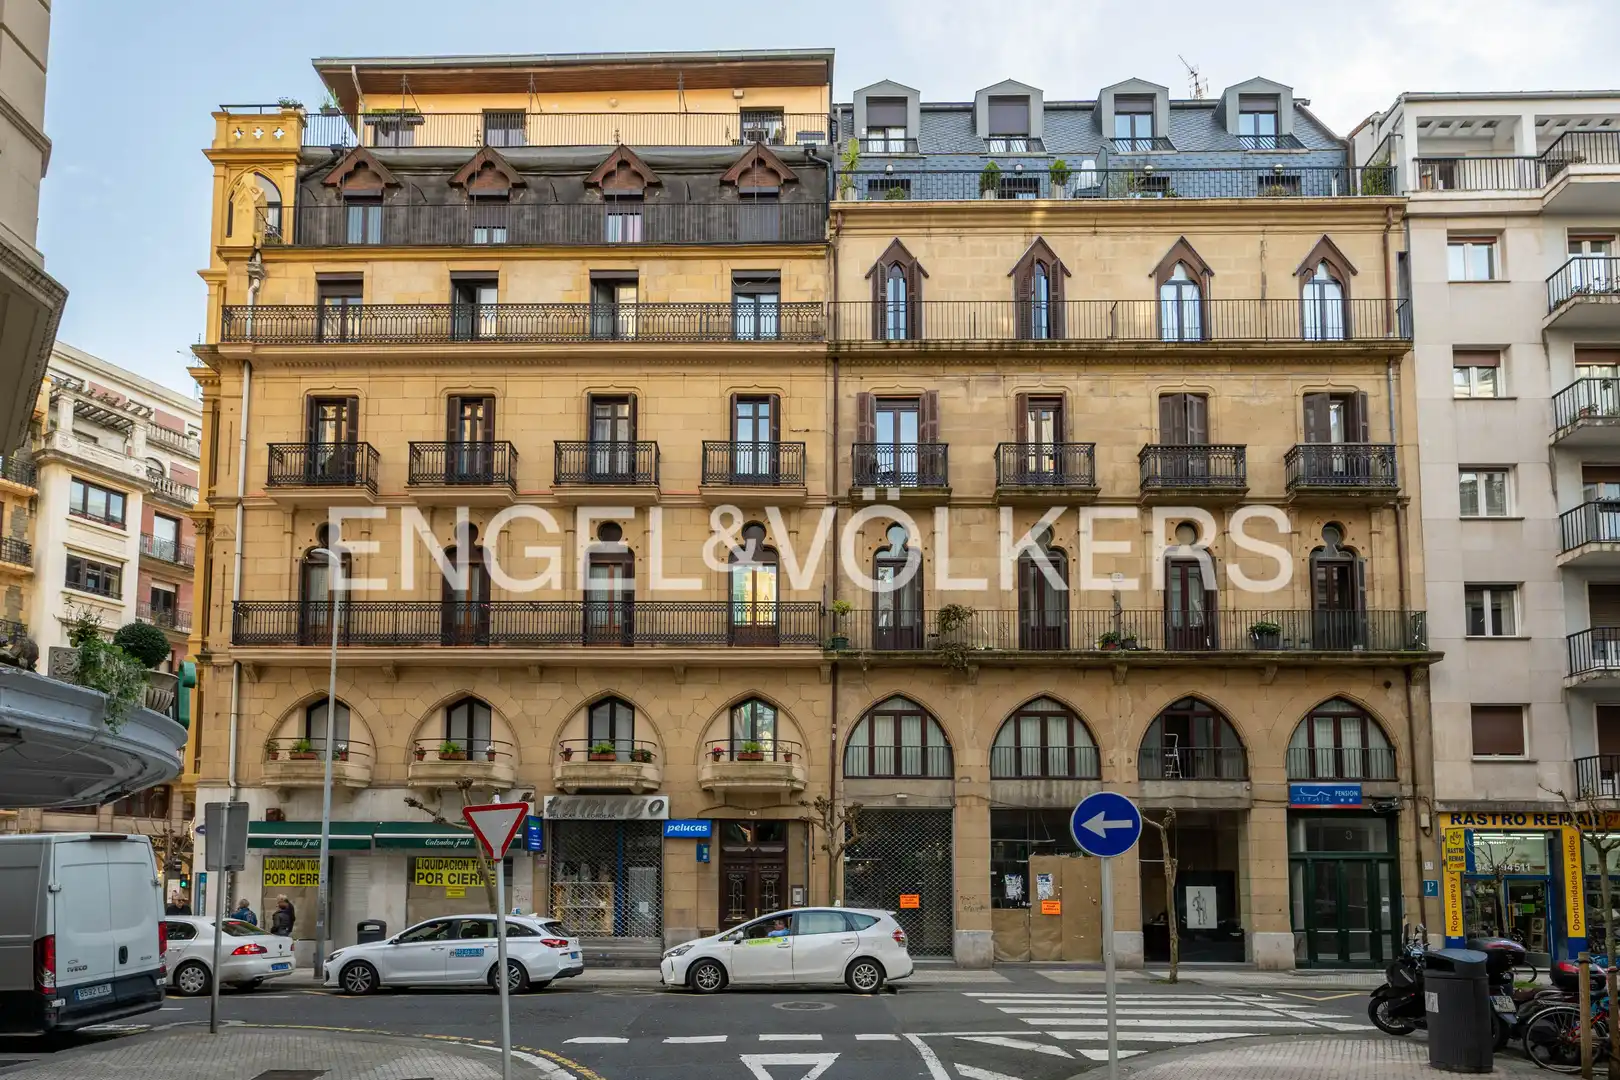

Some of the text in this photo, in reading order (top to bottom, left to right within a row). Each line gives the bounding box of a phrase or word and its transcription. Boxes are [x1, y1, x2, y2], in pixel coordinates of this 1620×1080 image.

[1451, 813, 1527, 825] RASTRO
[1533, 813, 1600, 825] REMAR
[667, 824, 708, 833] pelucas
[425, 838, 454, 846] Calzados
[307, 860, 320, 870] TOT
[265, 873, 320, 884] POR CIERR
[417, 873, 443, 884] POR
[1571, 871, 1580, 931] Oportunidades
[1451, 911, 1459, 931] Ropa
